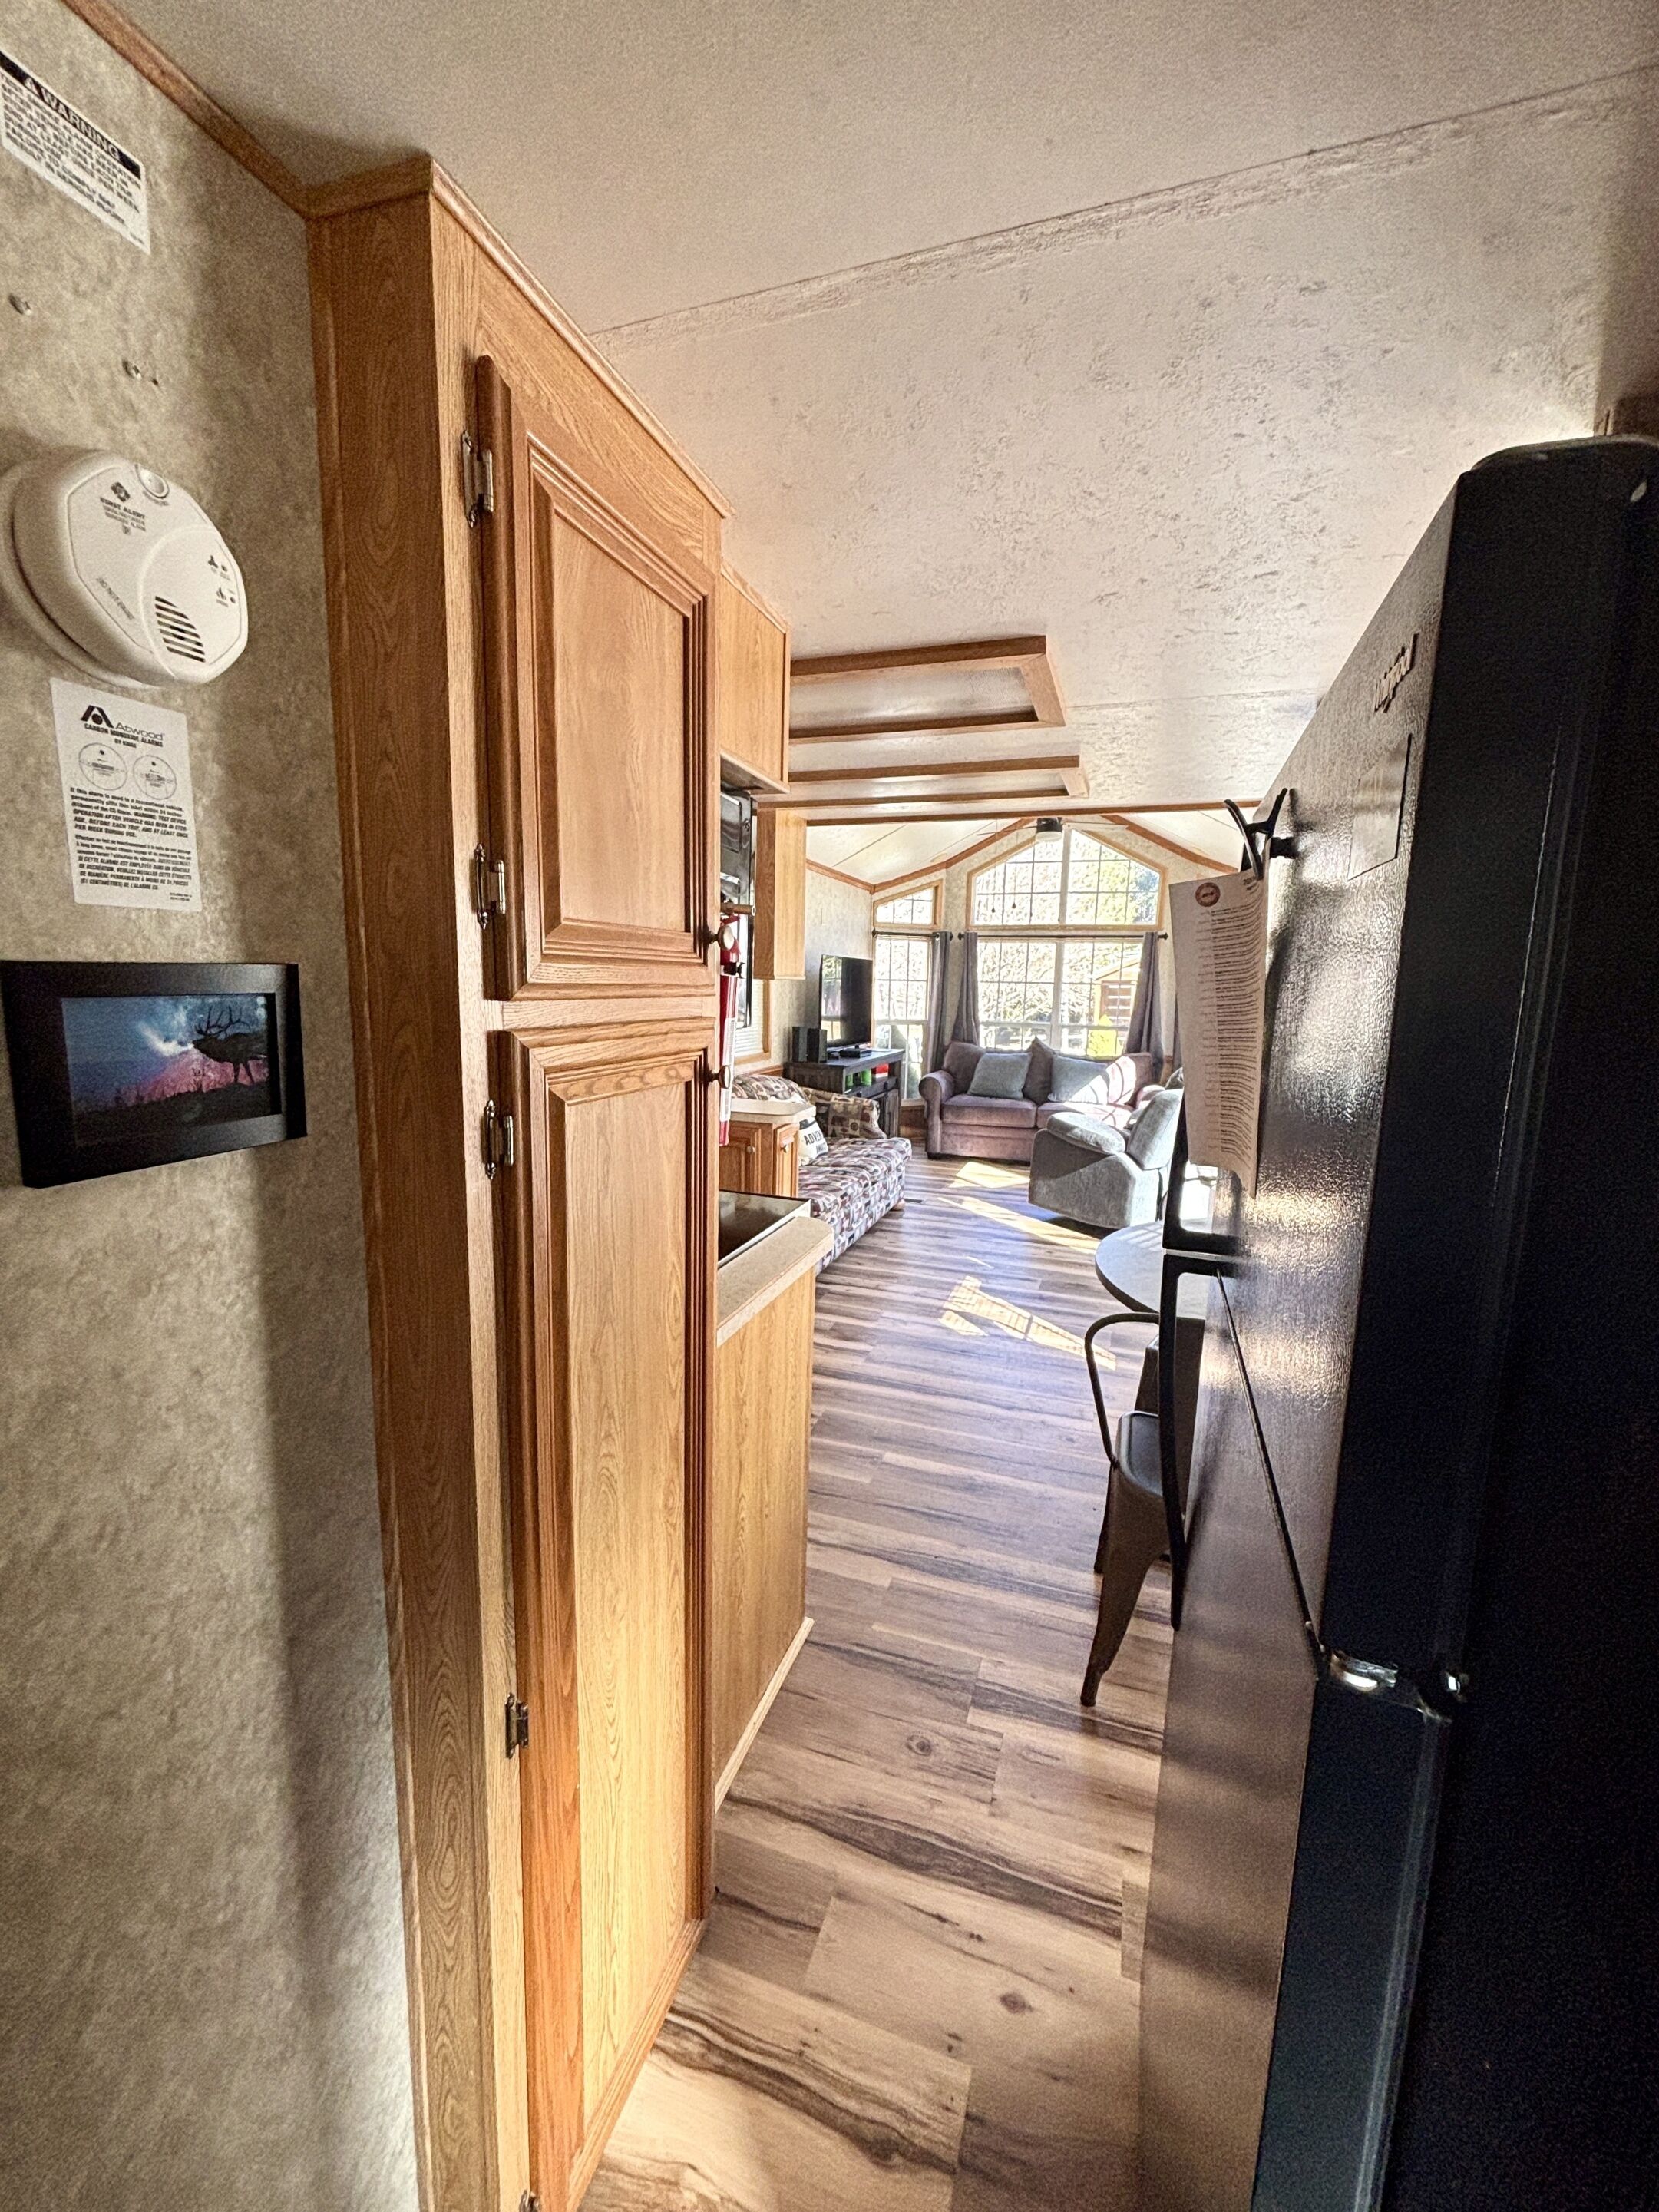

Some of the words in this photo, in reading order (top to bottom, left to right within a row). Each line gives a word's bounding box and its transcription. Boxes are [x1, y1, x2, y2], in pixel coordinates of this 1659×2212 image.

[41, 88, 119, 160] WARNING
[40, 131, 68, 158] LEAST
[62, 165, 96, 195] COMPLY
[84, 722, 108, 734] CARBON
[109, 729, 139, 742] MONOXIDE
[140, 736, 163, 747] ALARMS
[114, 721, 163, 741] Atwood
[72, 808, 104, 818] OPERATION
[122, 816, 144, 825] VEHICLE
